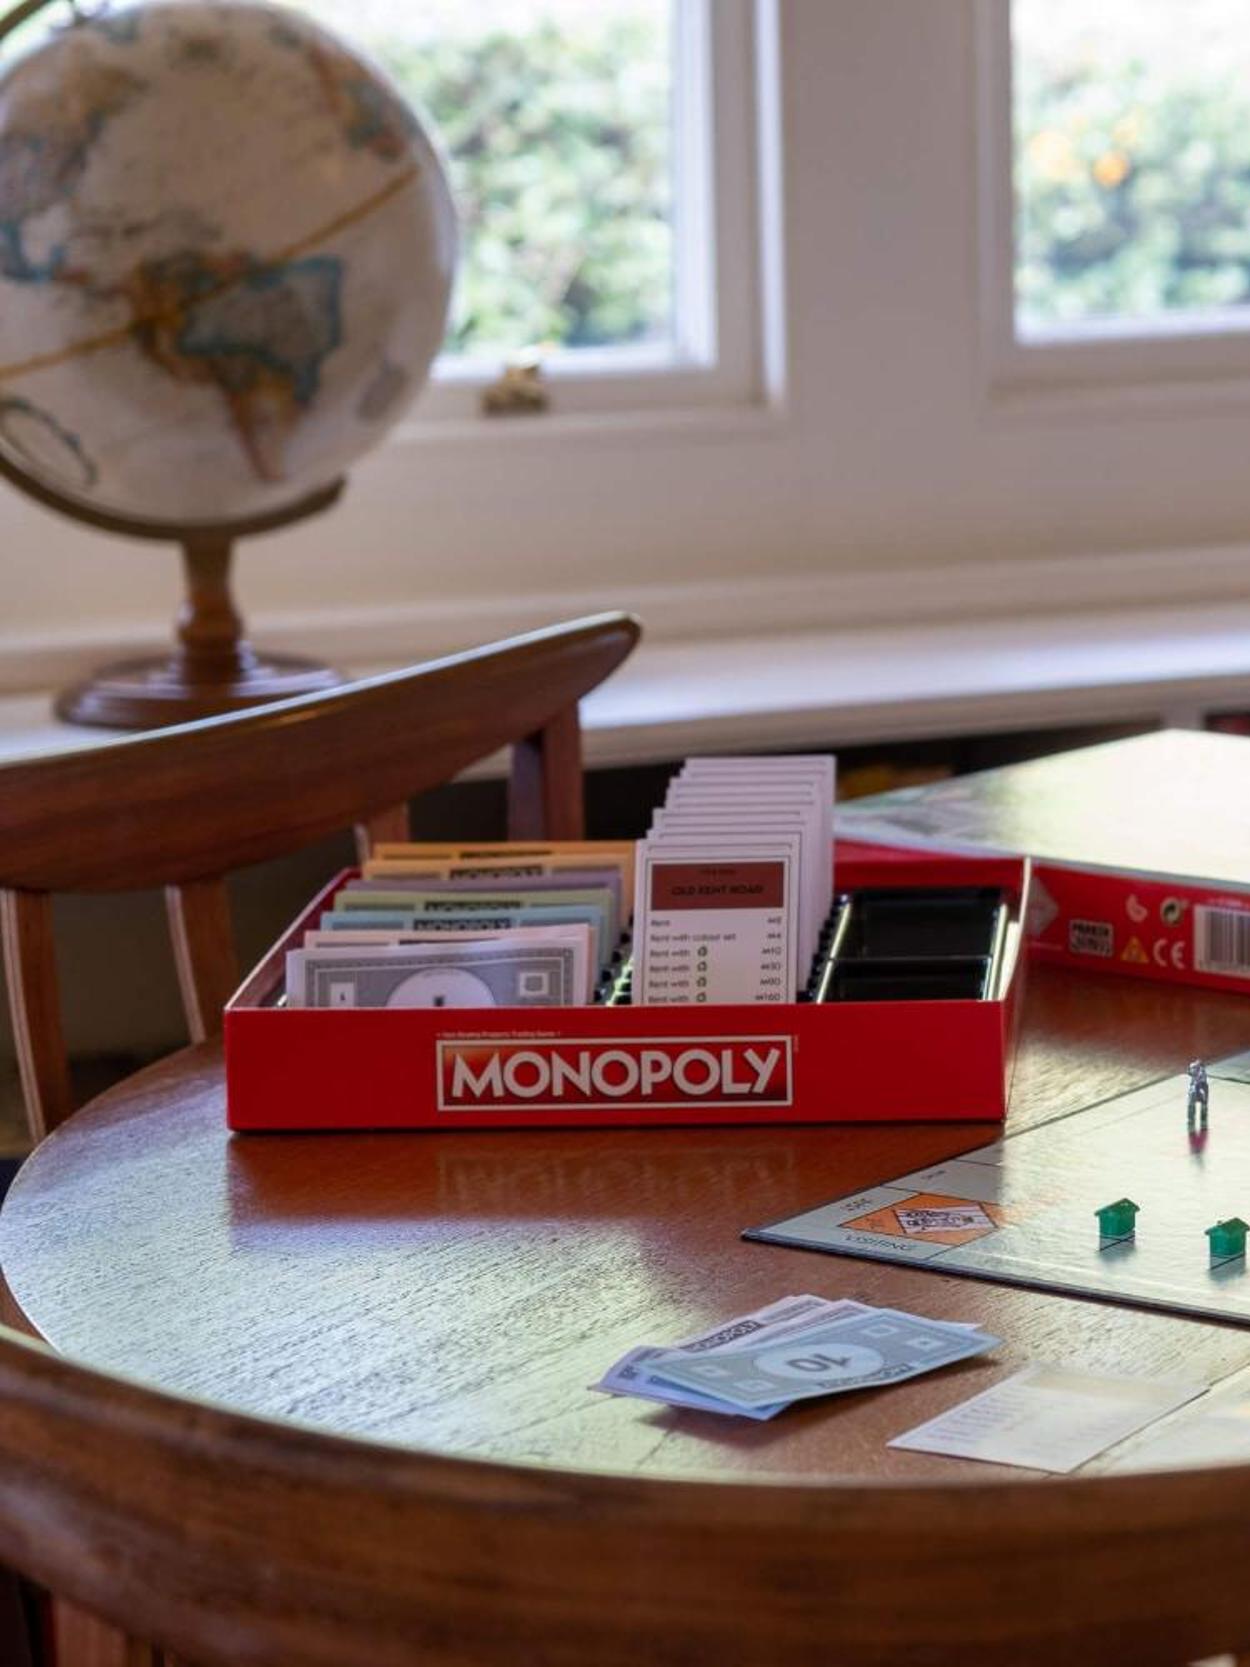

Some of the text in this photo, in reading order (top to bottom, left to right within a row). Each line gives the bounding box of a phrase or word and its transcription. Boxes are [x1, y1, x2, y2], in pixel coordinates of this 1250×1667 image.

[671, 885, 696, 896] OLD
[651, 919, 670, 928] Rent
[650, 934, 670, 943] Rent
[672, 933, 690, 942] with
[723, 932, 737, 941] set
[650, 949, 669, 958] Rent
[671, 949, 690, 957] with
[649, 964, 669, 973] Rent
[671, 964, 690, 973] with
[649, 980, 668, 989] Rent
[670, 980, 690, 988] with
[648, 995, 668, 1004] Rent
[669, 995, 689, 1003] with
[451, 1048, 781, 1098] MONOPOLY
[787, 1352, 852, 1373] 10
